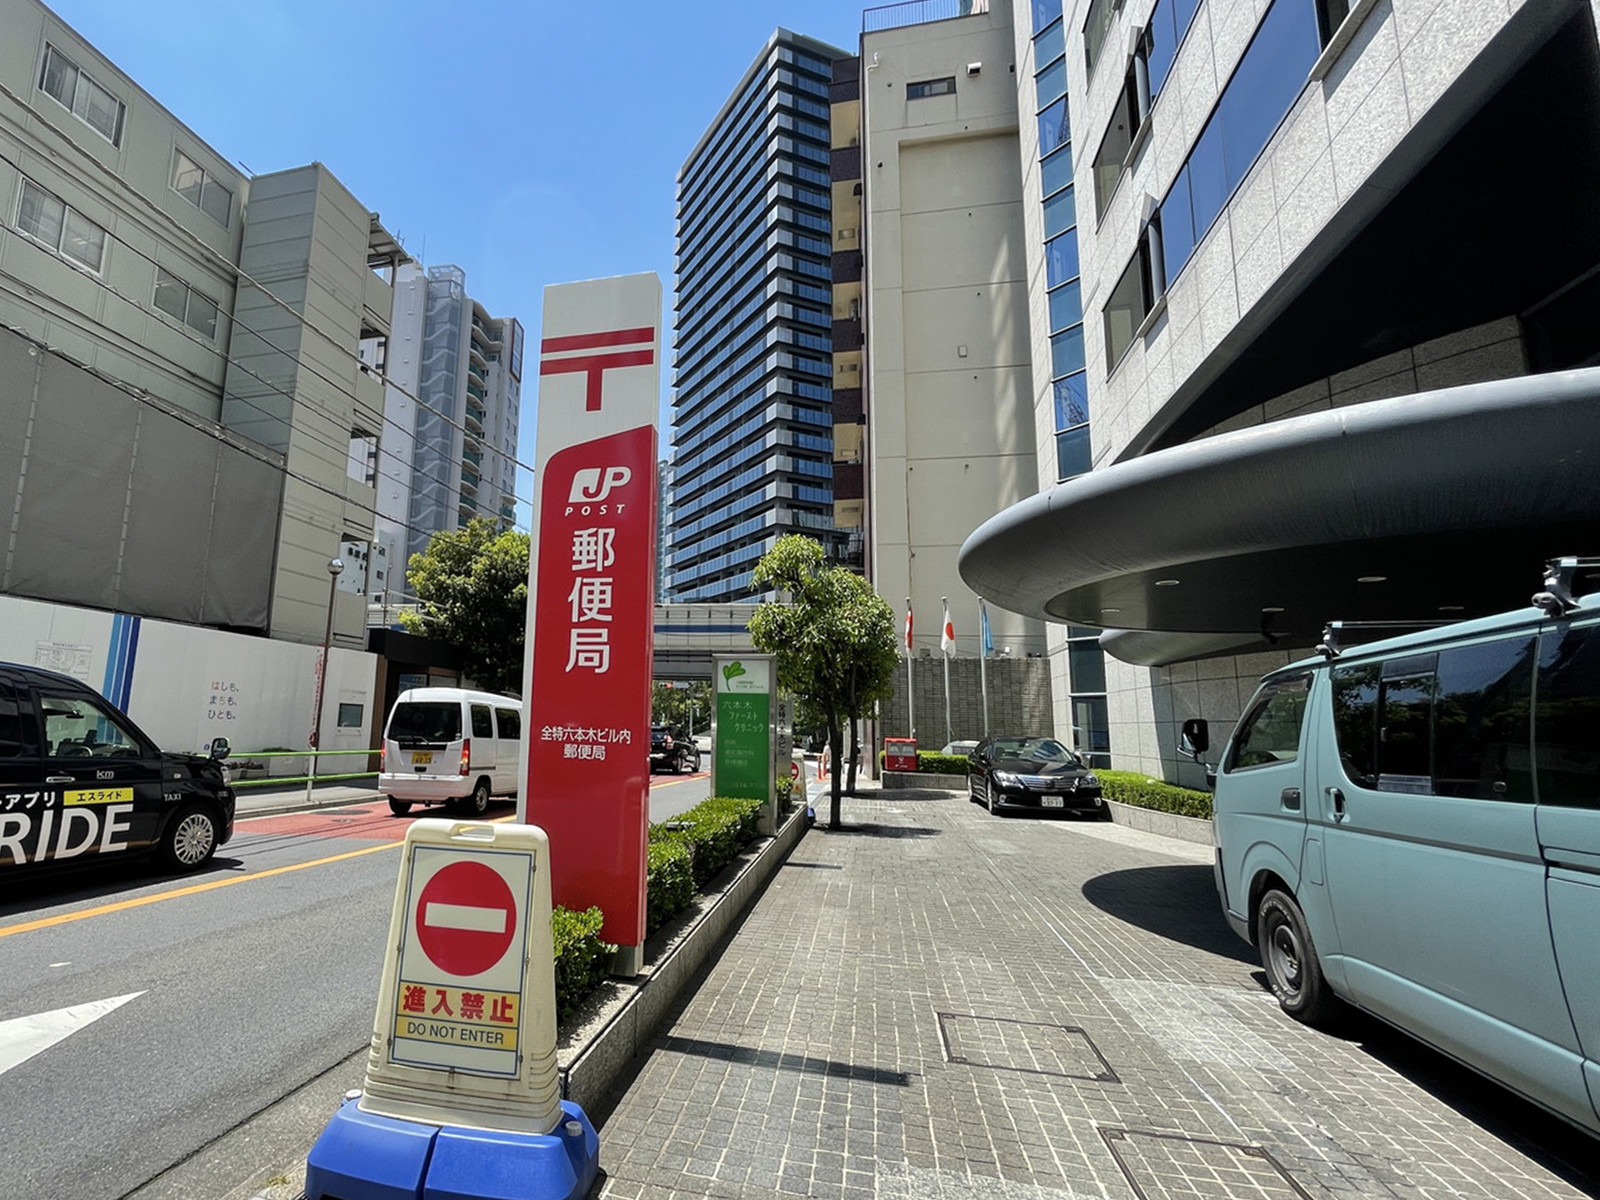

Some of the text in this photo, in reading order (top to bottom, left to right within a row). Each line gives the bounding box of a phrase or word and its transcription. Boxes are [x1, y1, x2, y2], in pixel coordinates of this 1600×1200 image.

[568, 466, 632, 503] JP
[565, 504, 626, 517] POST
[565, 527, 616, 674] 郵便局
[722, 701, 753, 710] 六本木
[729, 711, 758, 720] ファースト
[541, 725, 631, 744] 全特六本木ビル内
[734, 723, 764, 733] クリニック
[563, 743, 606, 761] 郵便局
[0, 791, 56, 811] アプリ
[76, 790, 123, 802] エスライド
[164, 793, 182, 802] TAXI
[0, 804, 134, 865] RIDE
[403, 985, 514, 1022] 進入禁止
[408, 1022, 504, 1045] DO NOT ENTER
